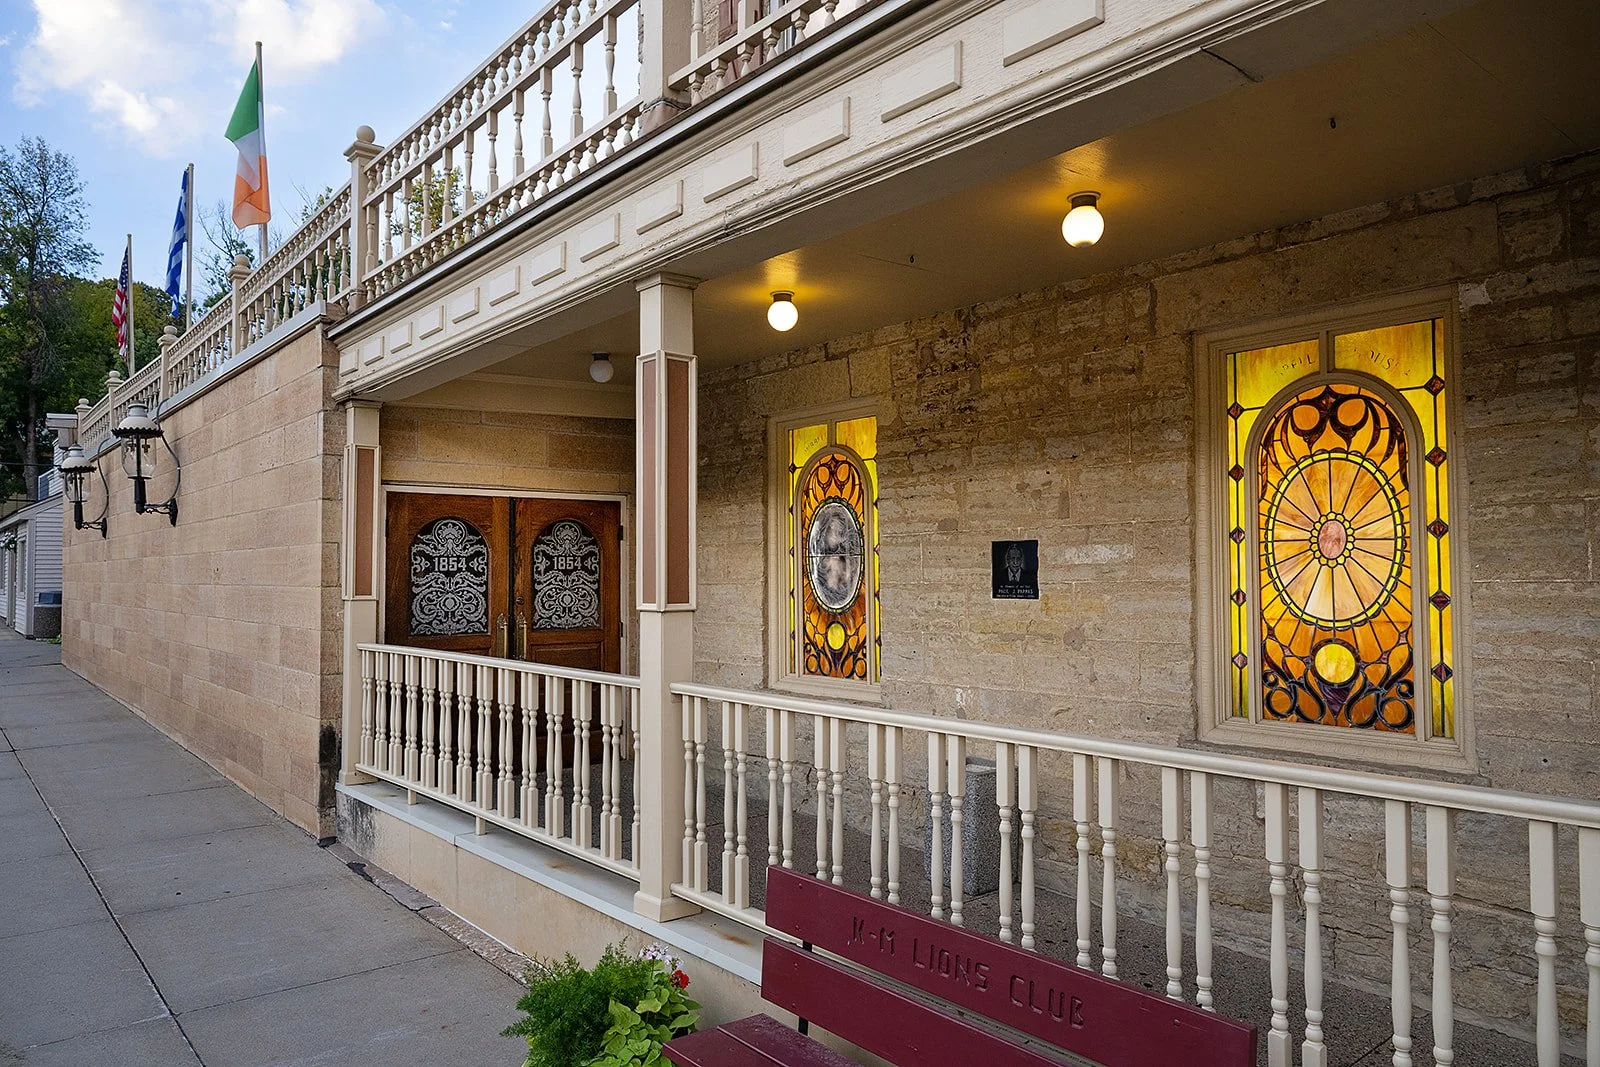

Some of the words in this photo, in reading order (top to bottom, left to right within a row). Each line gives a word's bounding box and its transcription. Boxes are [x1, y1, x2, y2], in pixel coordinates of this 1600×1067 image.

[433, 556, 467, 572] 1854
[552, 556, 582, 570] 1854
[852, 914, 896, 957] K-M
[912, 938, 990, 992] LIONS
[1009, 974, 1085, 1030] CLUB
